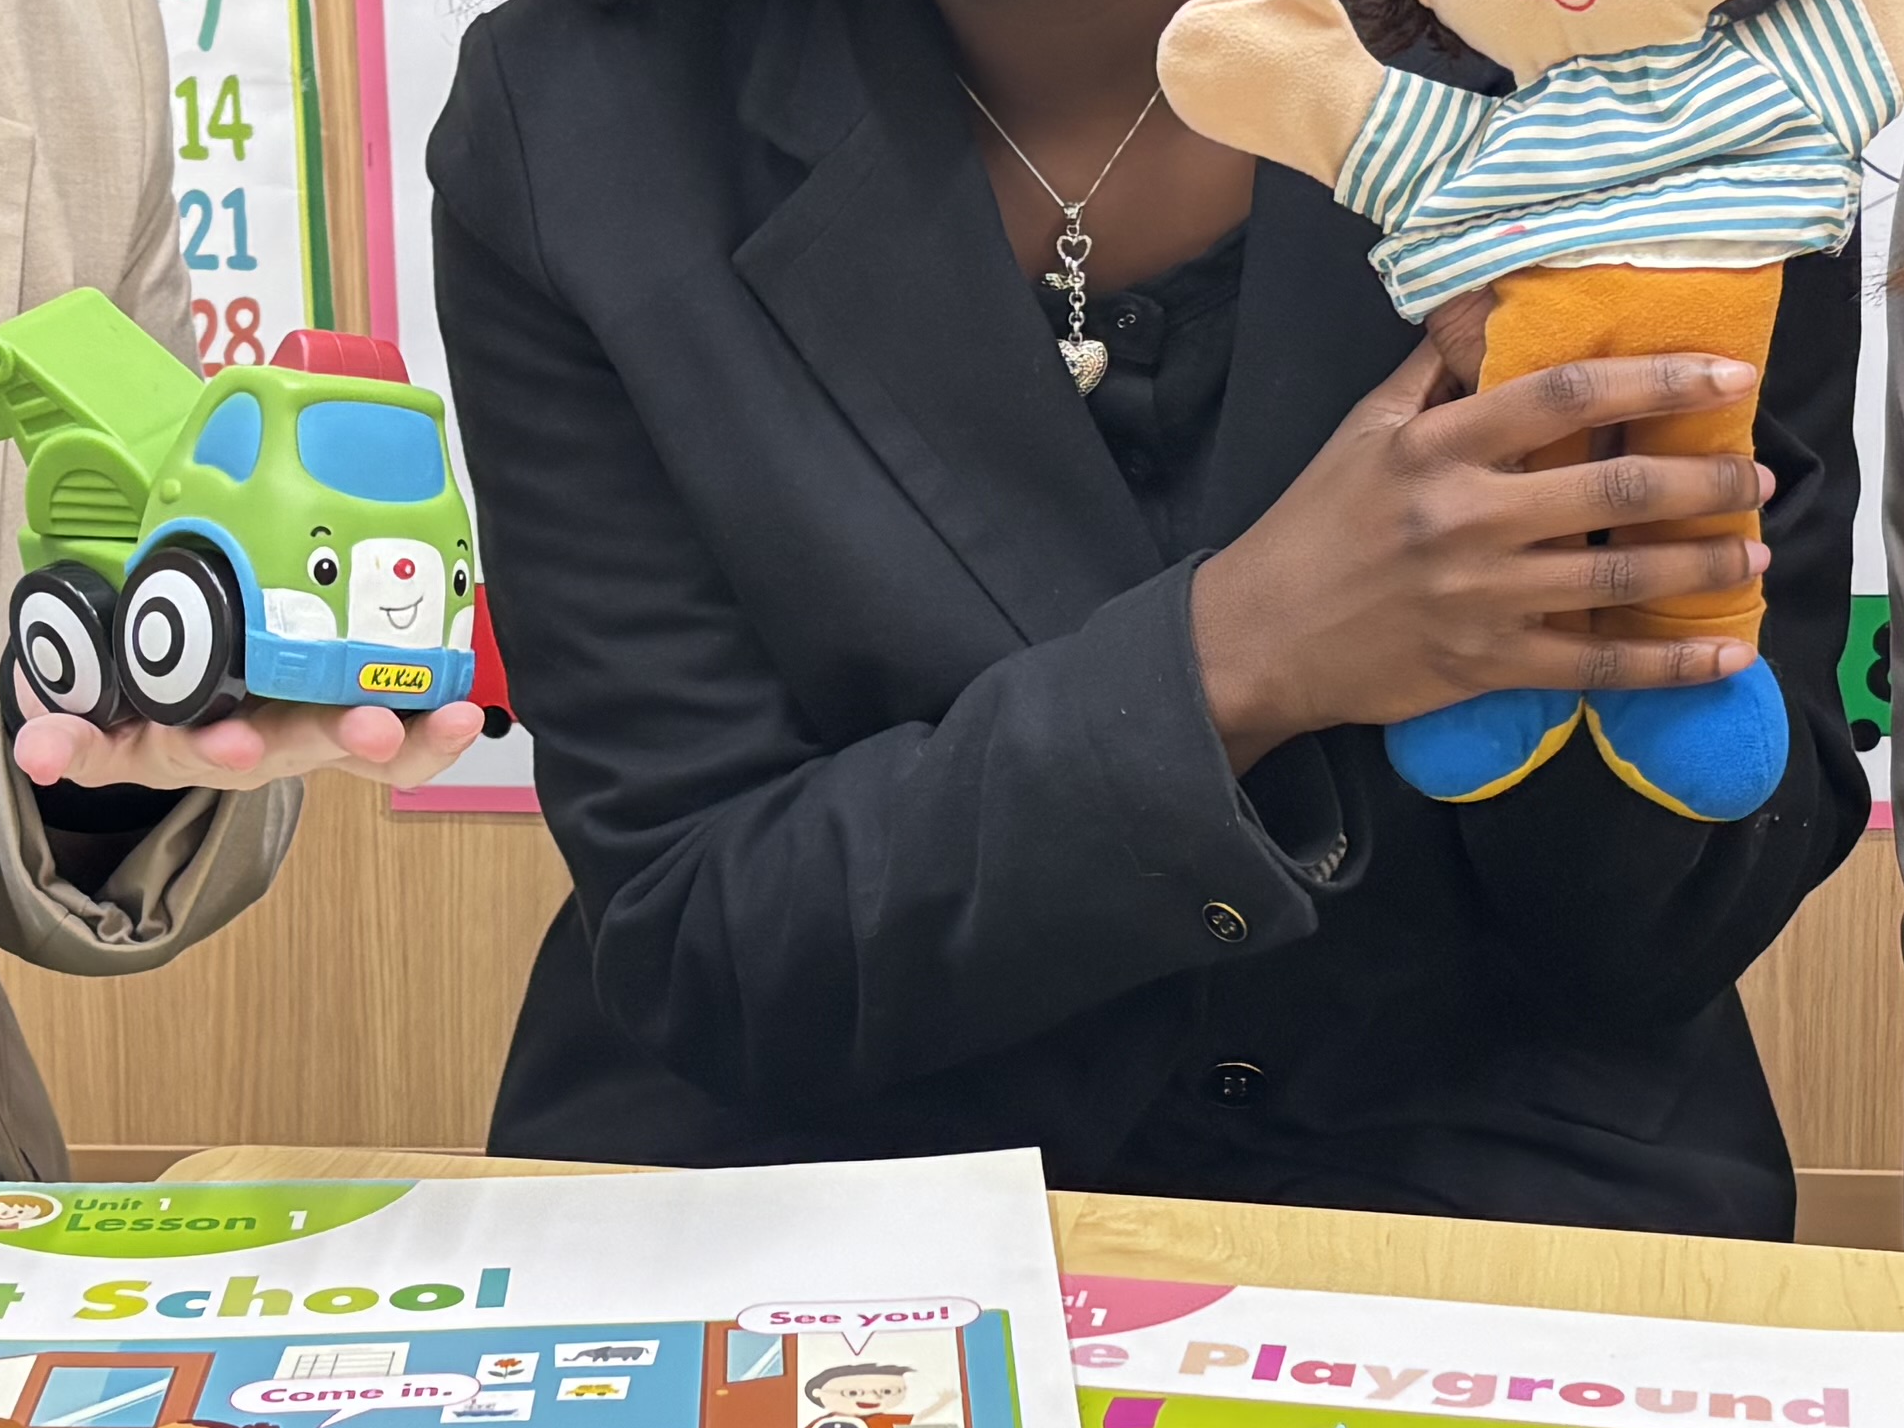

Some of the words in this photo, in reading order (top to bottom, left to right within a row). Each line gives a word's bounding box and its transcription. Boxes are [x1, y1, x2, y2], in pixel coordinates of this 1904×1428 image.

[175, 74, 254, 161] 14
[179, 187, 258, 271] 21
[191, 297, 266, 378] 28
[65, 1212, 257, 1232] Lesson
[288, 1210, 308, 1231] 1
[74, 1198, 144, 1211] Unit
[159, 1197, 172, 1211] 1
[73, 1267, 511, 1320] School
[769, 1311, 843, 1325] See
[857, 1306, 950, 1328] you!
[260, 1388, 385, 1403] Come
[401, 1383, 453, 1398] in.
[1177, 1340, 1851, 1428] Playground
